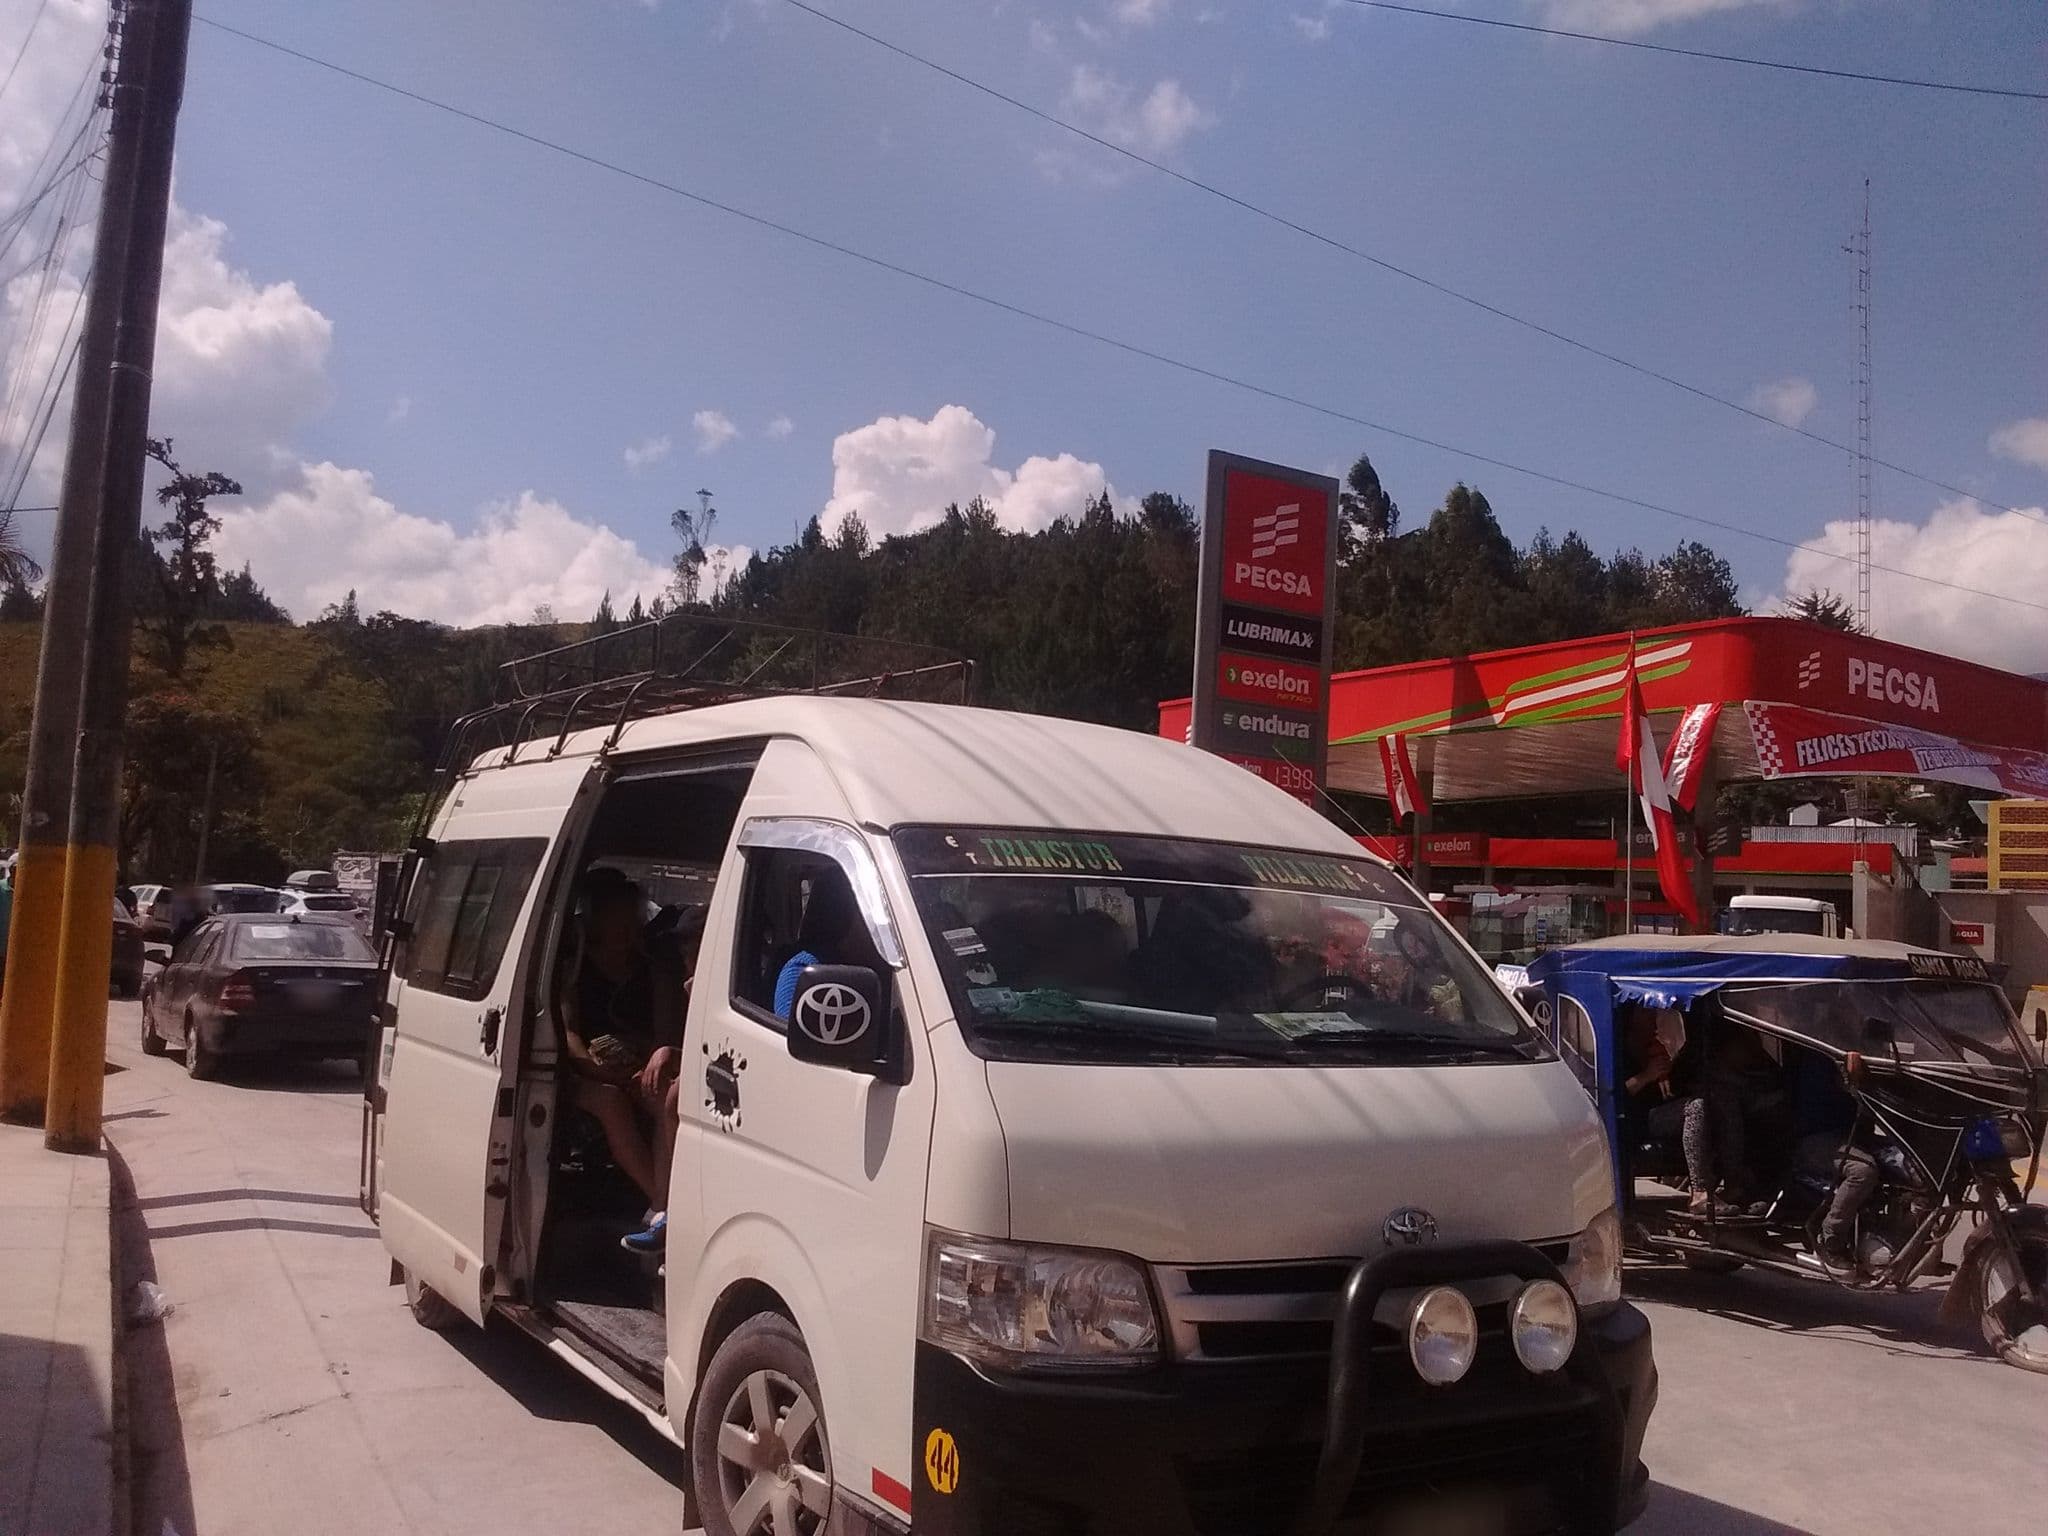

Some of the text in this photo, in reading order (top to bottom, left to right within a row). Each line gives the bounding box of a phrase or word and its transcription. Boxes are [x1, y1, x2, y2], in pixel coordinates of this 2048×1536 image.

[1235, 562, 1312, 597] PECSA
[1227, 619, 1314, 648] LUBRIMAX
[1241, 669, 1310, 694] exelon
[1848, 658, 1940, 713] PECSA
[1238, 714, 1310, 739] endura
[1796, 733, 1857, 767] FELICES
[1433, 837, 1471, 852] exelon
[1956, 930, 1979, 938] AGUA
[930, 1437, 955, 1491] 44
